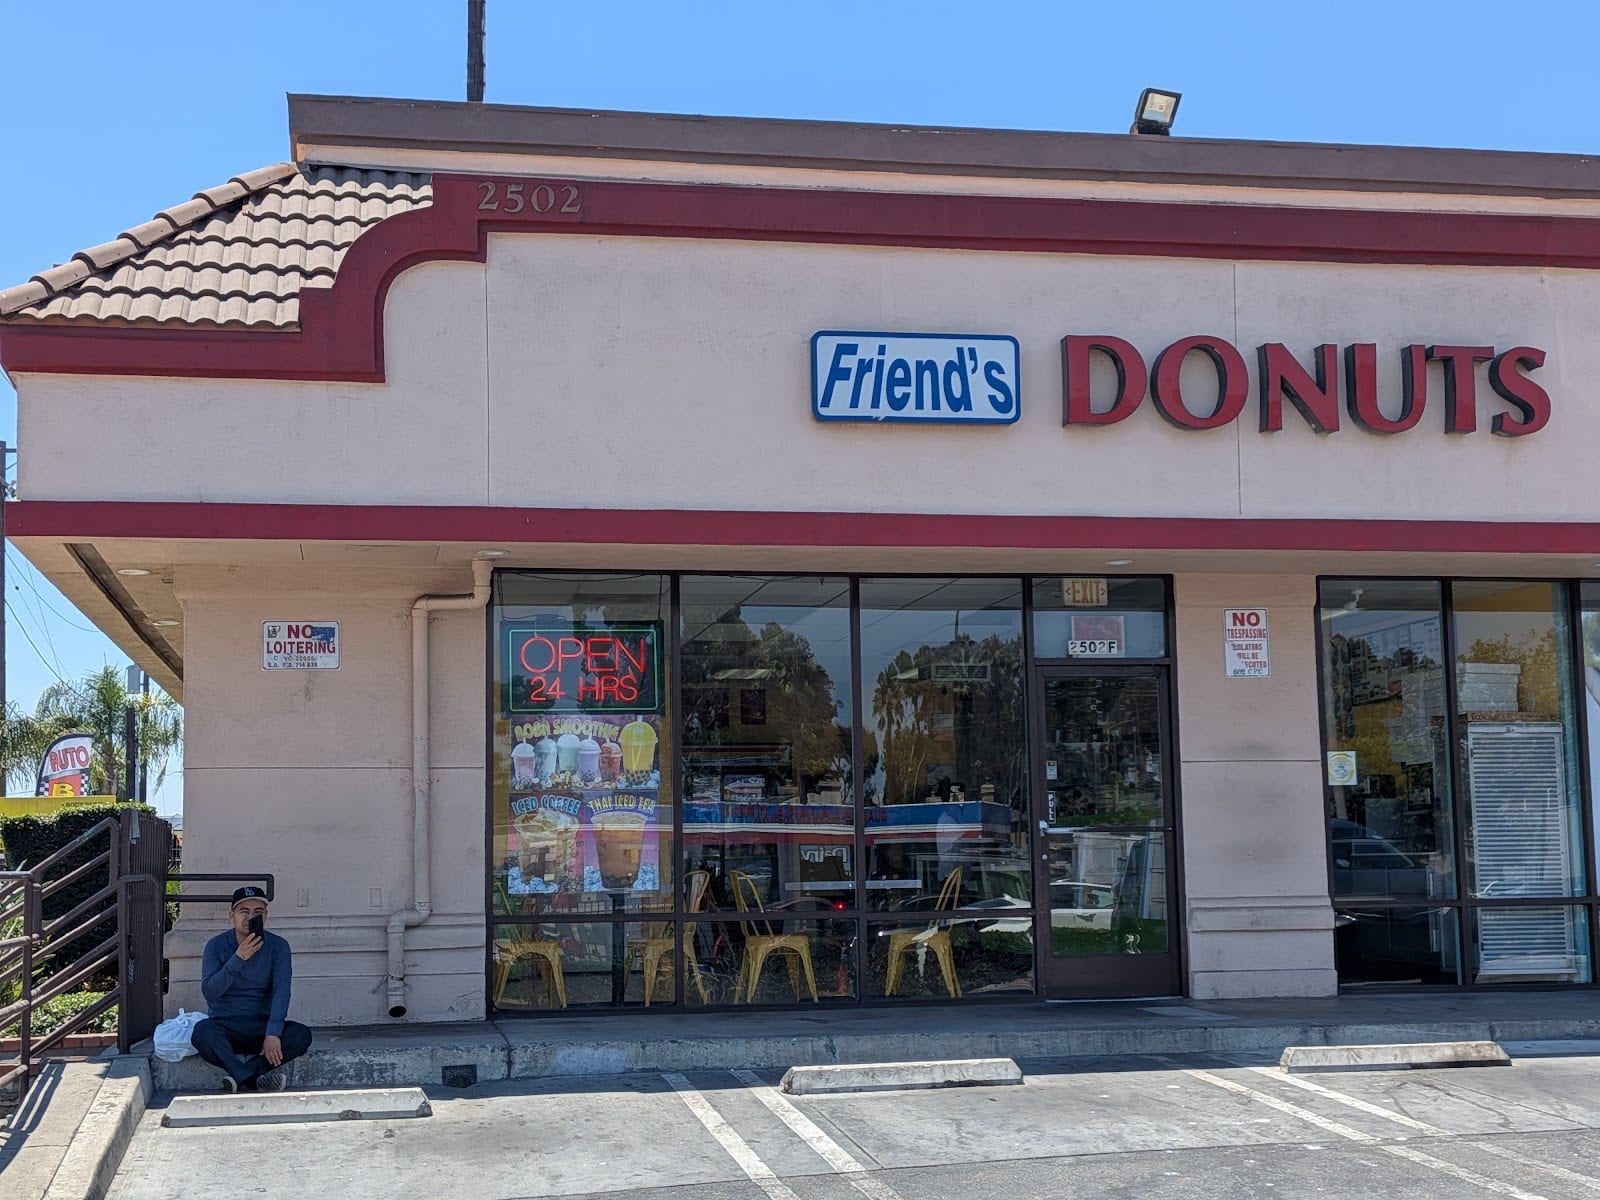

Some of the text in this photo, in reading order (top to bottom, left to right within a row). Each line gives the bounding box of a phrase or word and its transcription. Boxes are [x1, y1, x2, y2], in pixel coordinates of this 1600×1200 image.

[478, 181, 581, 213] 2502
[819, 334, 1552, 436] Friend's DONUTS
[1071, 579, 1102, 604] EXIT
[1232, 612, 1260, 627] NO
[287, 624, 314, 639] NO
[1227, 628, 1267, 639] TRESPASSING
[266, 641, 336, 654] LOITERING
[520, 636, 646, 674] OPEN
[530, 675, 639, 702] 24 HRS
[514, 718, 620, 741] BOBA SMOOTHIE
[49, 745, 90, 772] AUTO
[511, 794, 582, 815] ICED COFFEE
[588, 794, 656, 815] THAI ICED TEA
